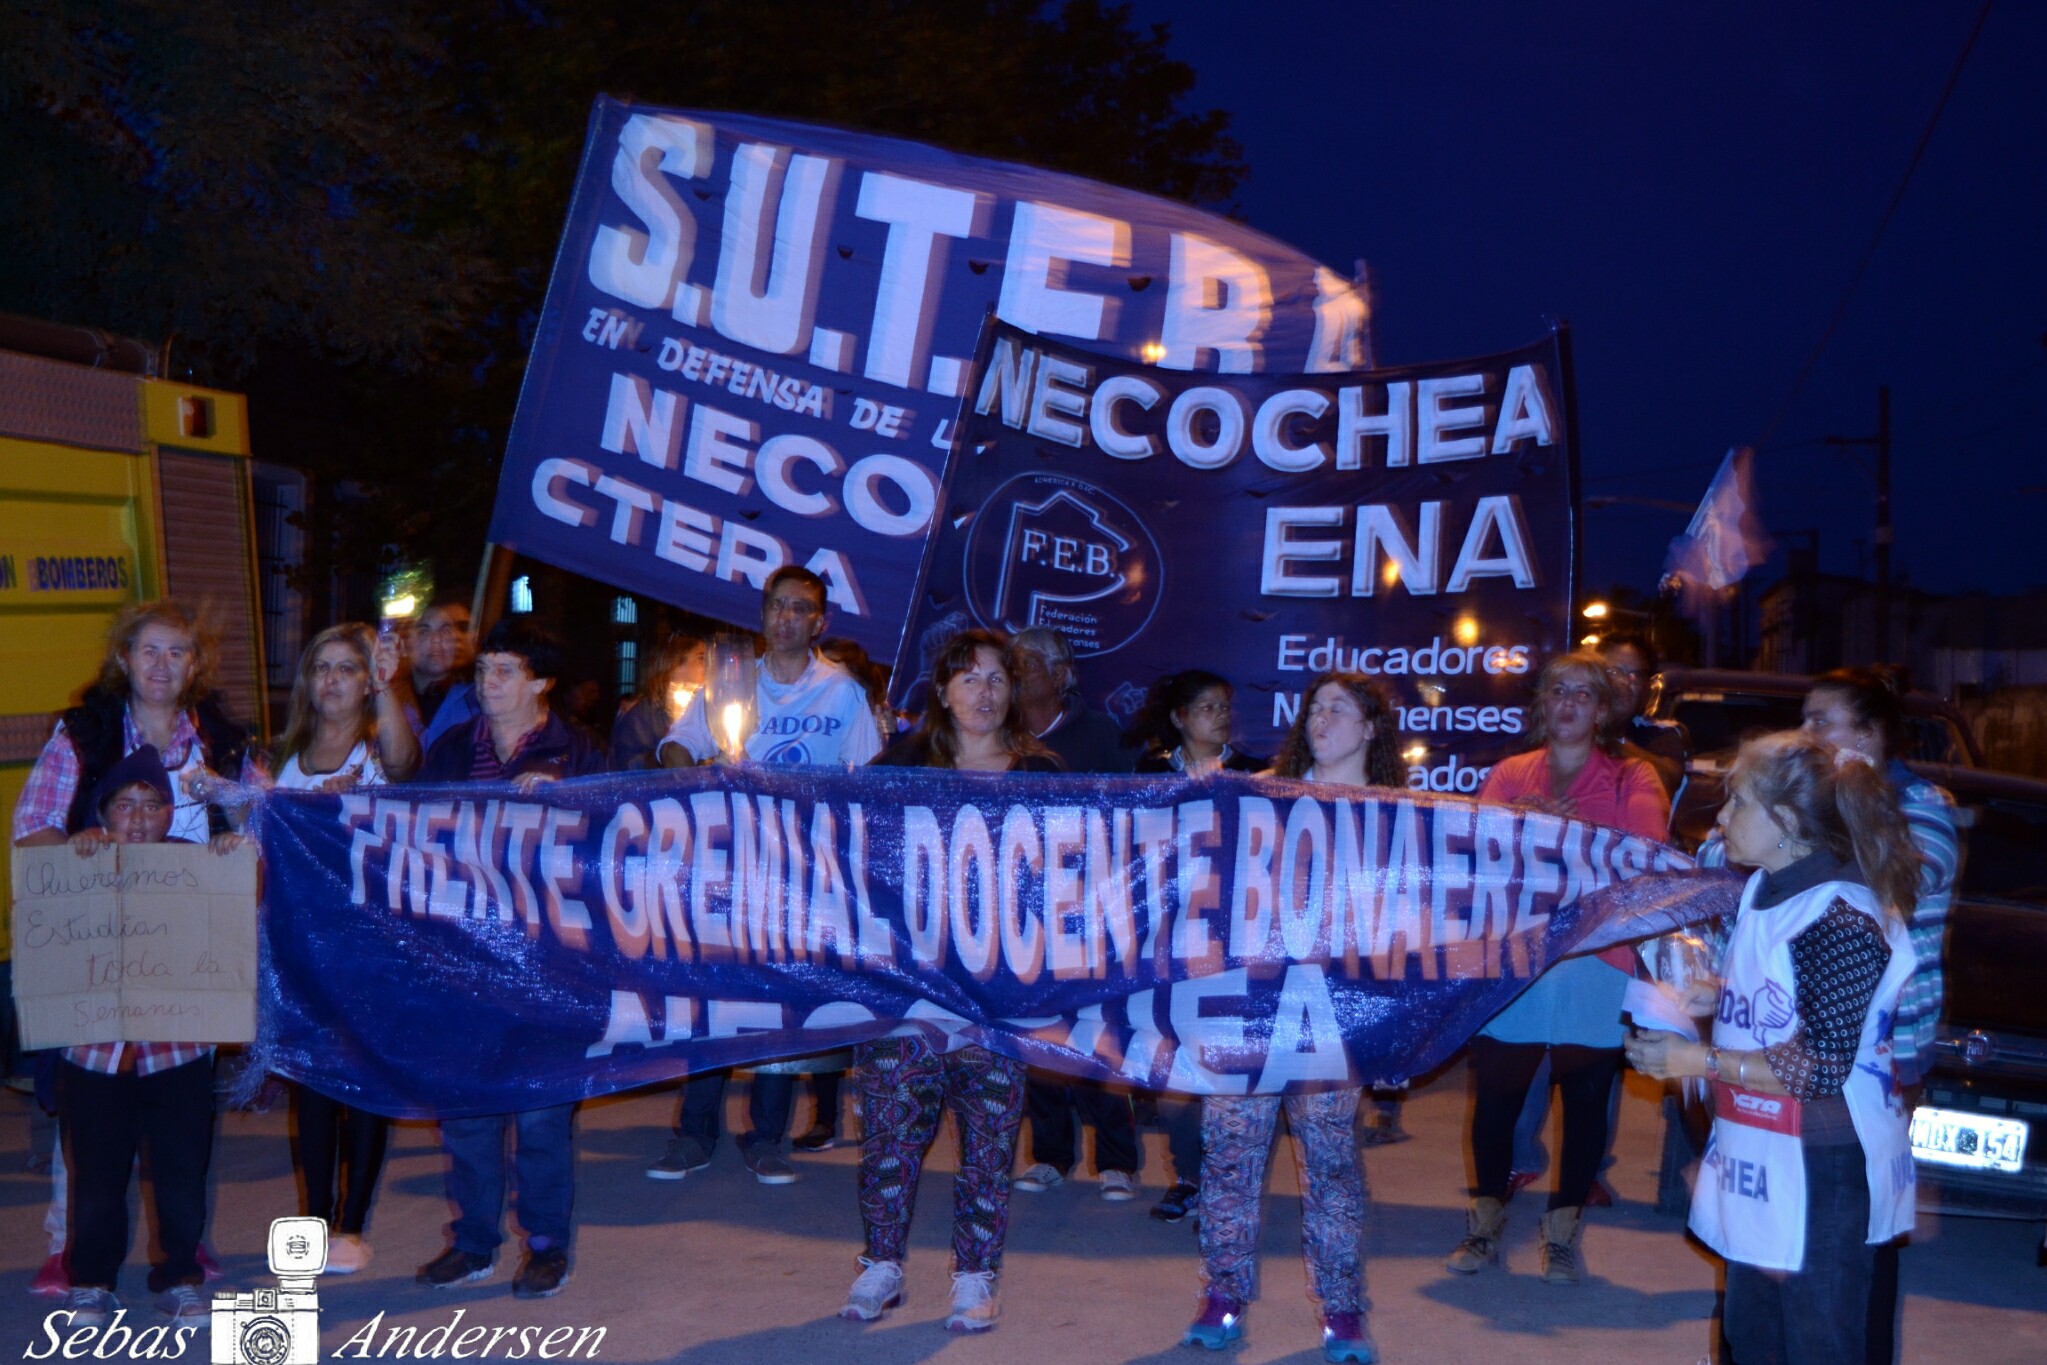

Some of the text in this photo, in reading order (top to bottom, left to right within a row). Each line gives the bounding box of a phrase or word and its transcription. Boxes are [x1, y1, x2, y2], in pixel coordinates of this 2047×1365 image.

[582, 307, 634, 349] EN
[657, 337, 825, 418] DEFENSA
[850, 398, 910, 437] DE
[974, 336, 1553, 472] NECOCHEA
[531, 457, 864, 615] CTERA
[1021, 529, 1116, 579] F.E.B.
[1260, 495, 1538, 598] ENA
[36, 556, 128, 590] BOMBEROS
[1040, 605, 1098, 625] Federación
[1277, 635, 1529, 675] Educadores
[757, 714, 842, 737] ADOP
[26, 862, 199, 896] Queremos
[338, 795, 592, 932] FRENTE
[601, 791, 893, 960] GREMIAL
[903, 799, 1219, 974] DOCENTE
[190, 951, 226, 975] la
[1736, 1093, 1782, 1114] CTA
[1977, 1127, 2021, 1163] 154
